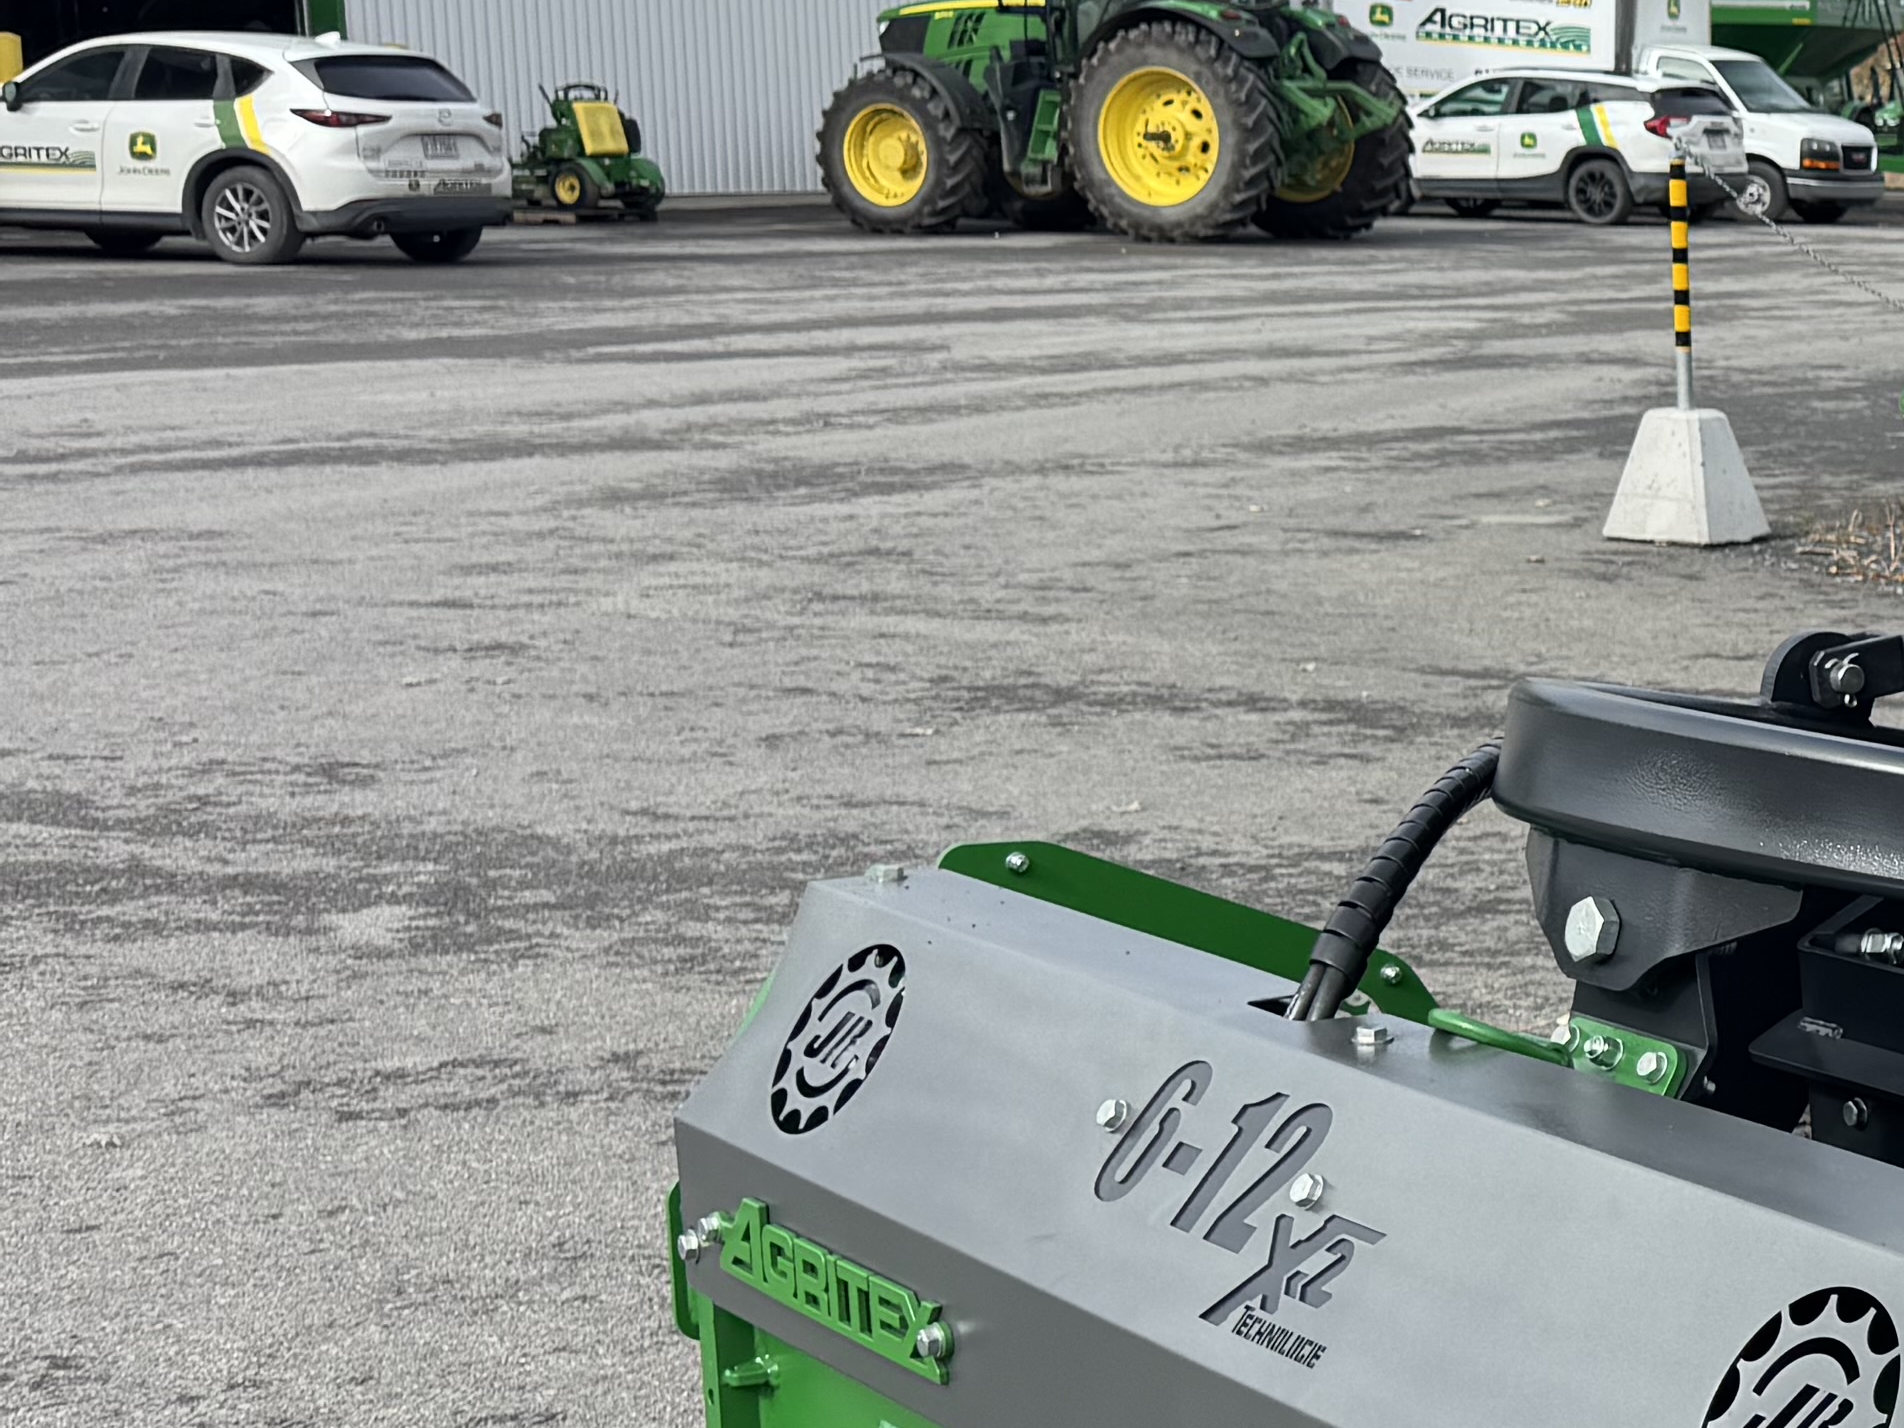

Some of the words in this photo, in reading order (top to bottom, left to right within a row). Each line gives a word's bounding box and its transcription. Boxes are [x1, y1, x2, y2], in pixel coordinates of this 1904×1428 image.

[1418, 7, 1552, 39] AGRITEX
[0, 145, 70, 160] GRITEX
[719, 1196, 950, 1386] AGRITEX
